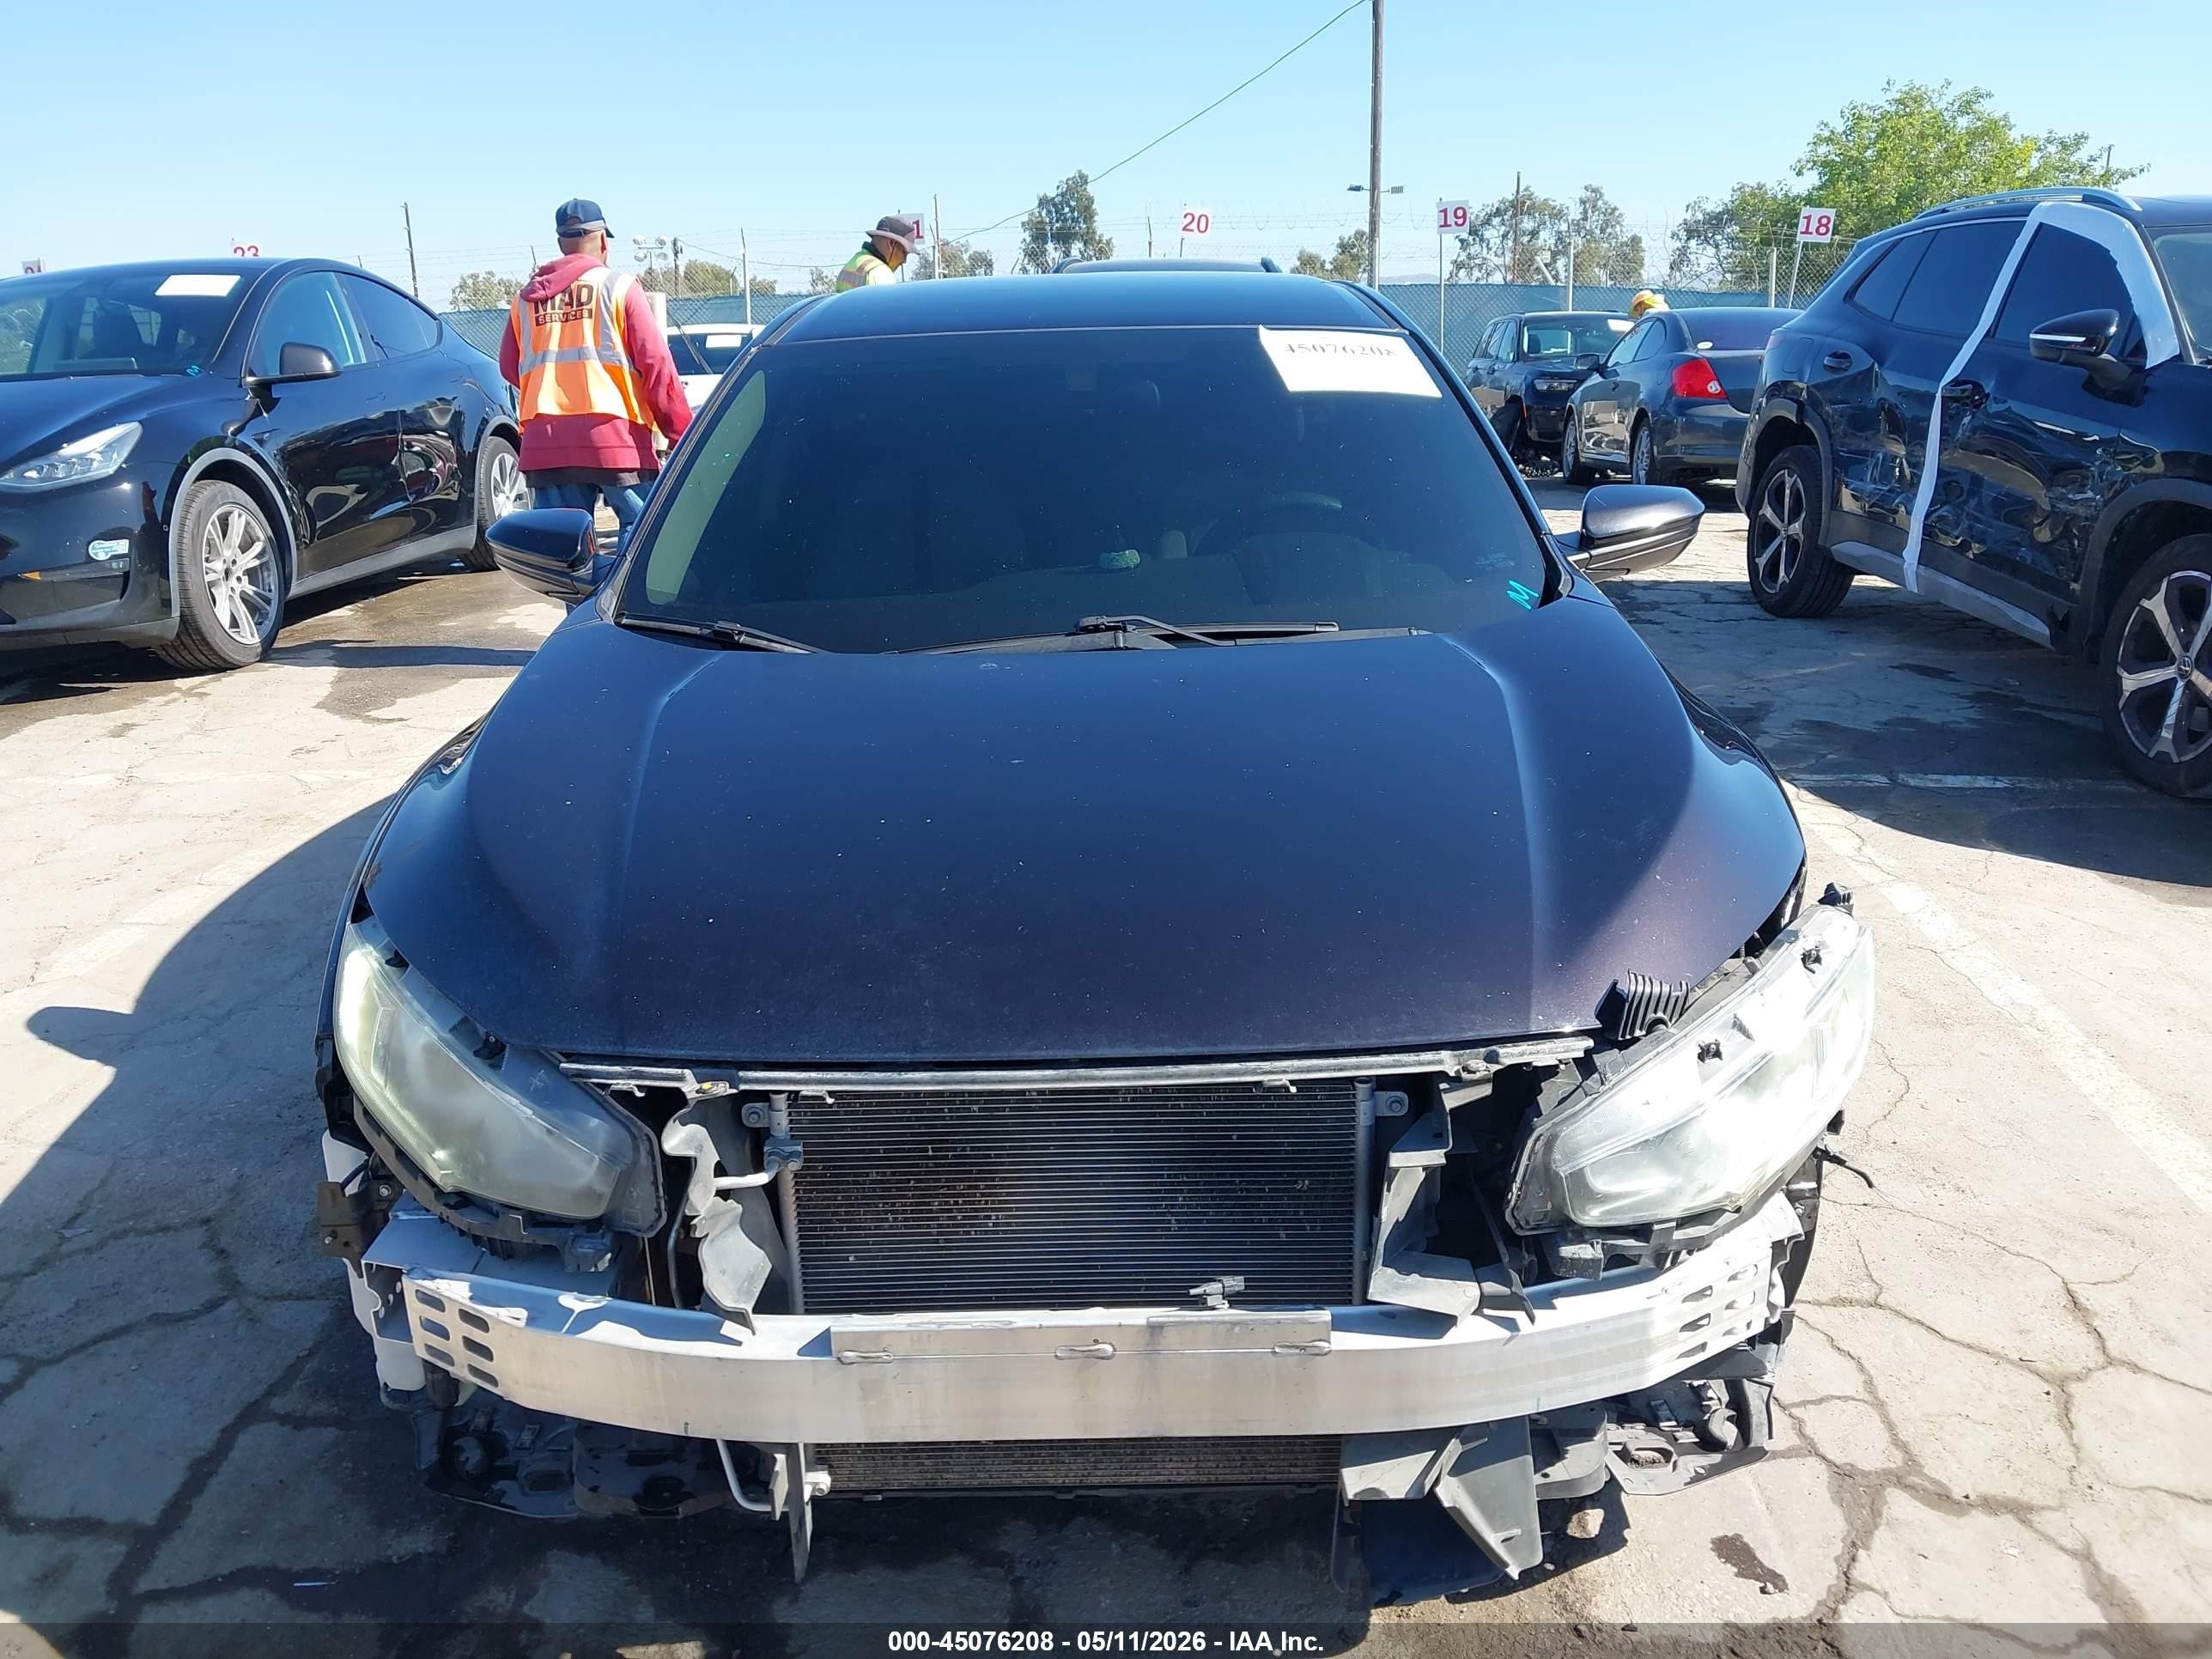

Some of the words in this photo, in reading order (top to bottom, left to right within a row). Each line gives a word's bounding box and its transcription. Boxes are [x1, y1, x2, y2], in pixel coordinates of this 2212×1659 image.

[1182, 212, 1209, 234] 20
[1438, 206, 1468, 228] 19
[1800, 214, 1832, 236] 18
[533, 283, 594, 314] MAD
[538, 309, 589, 325] SERVICES
